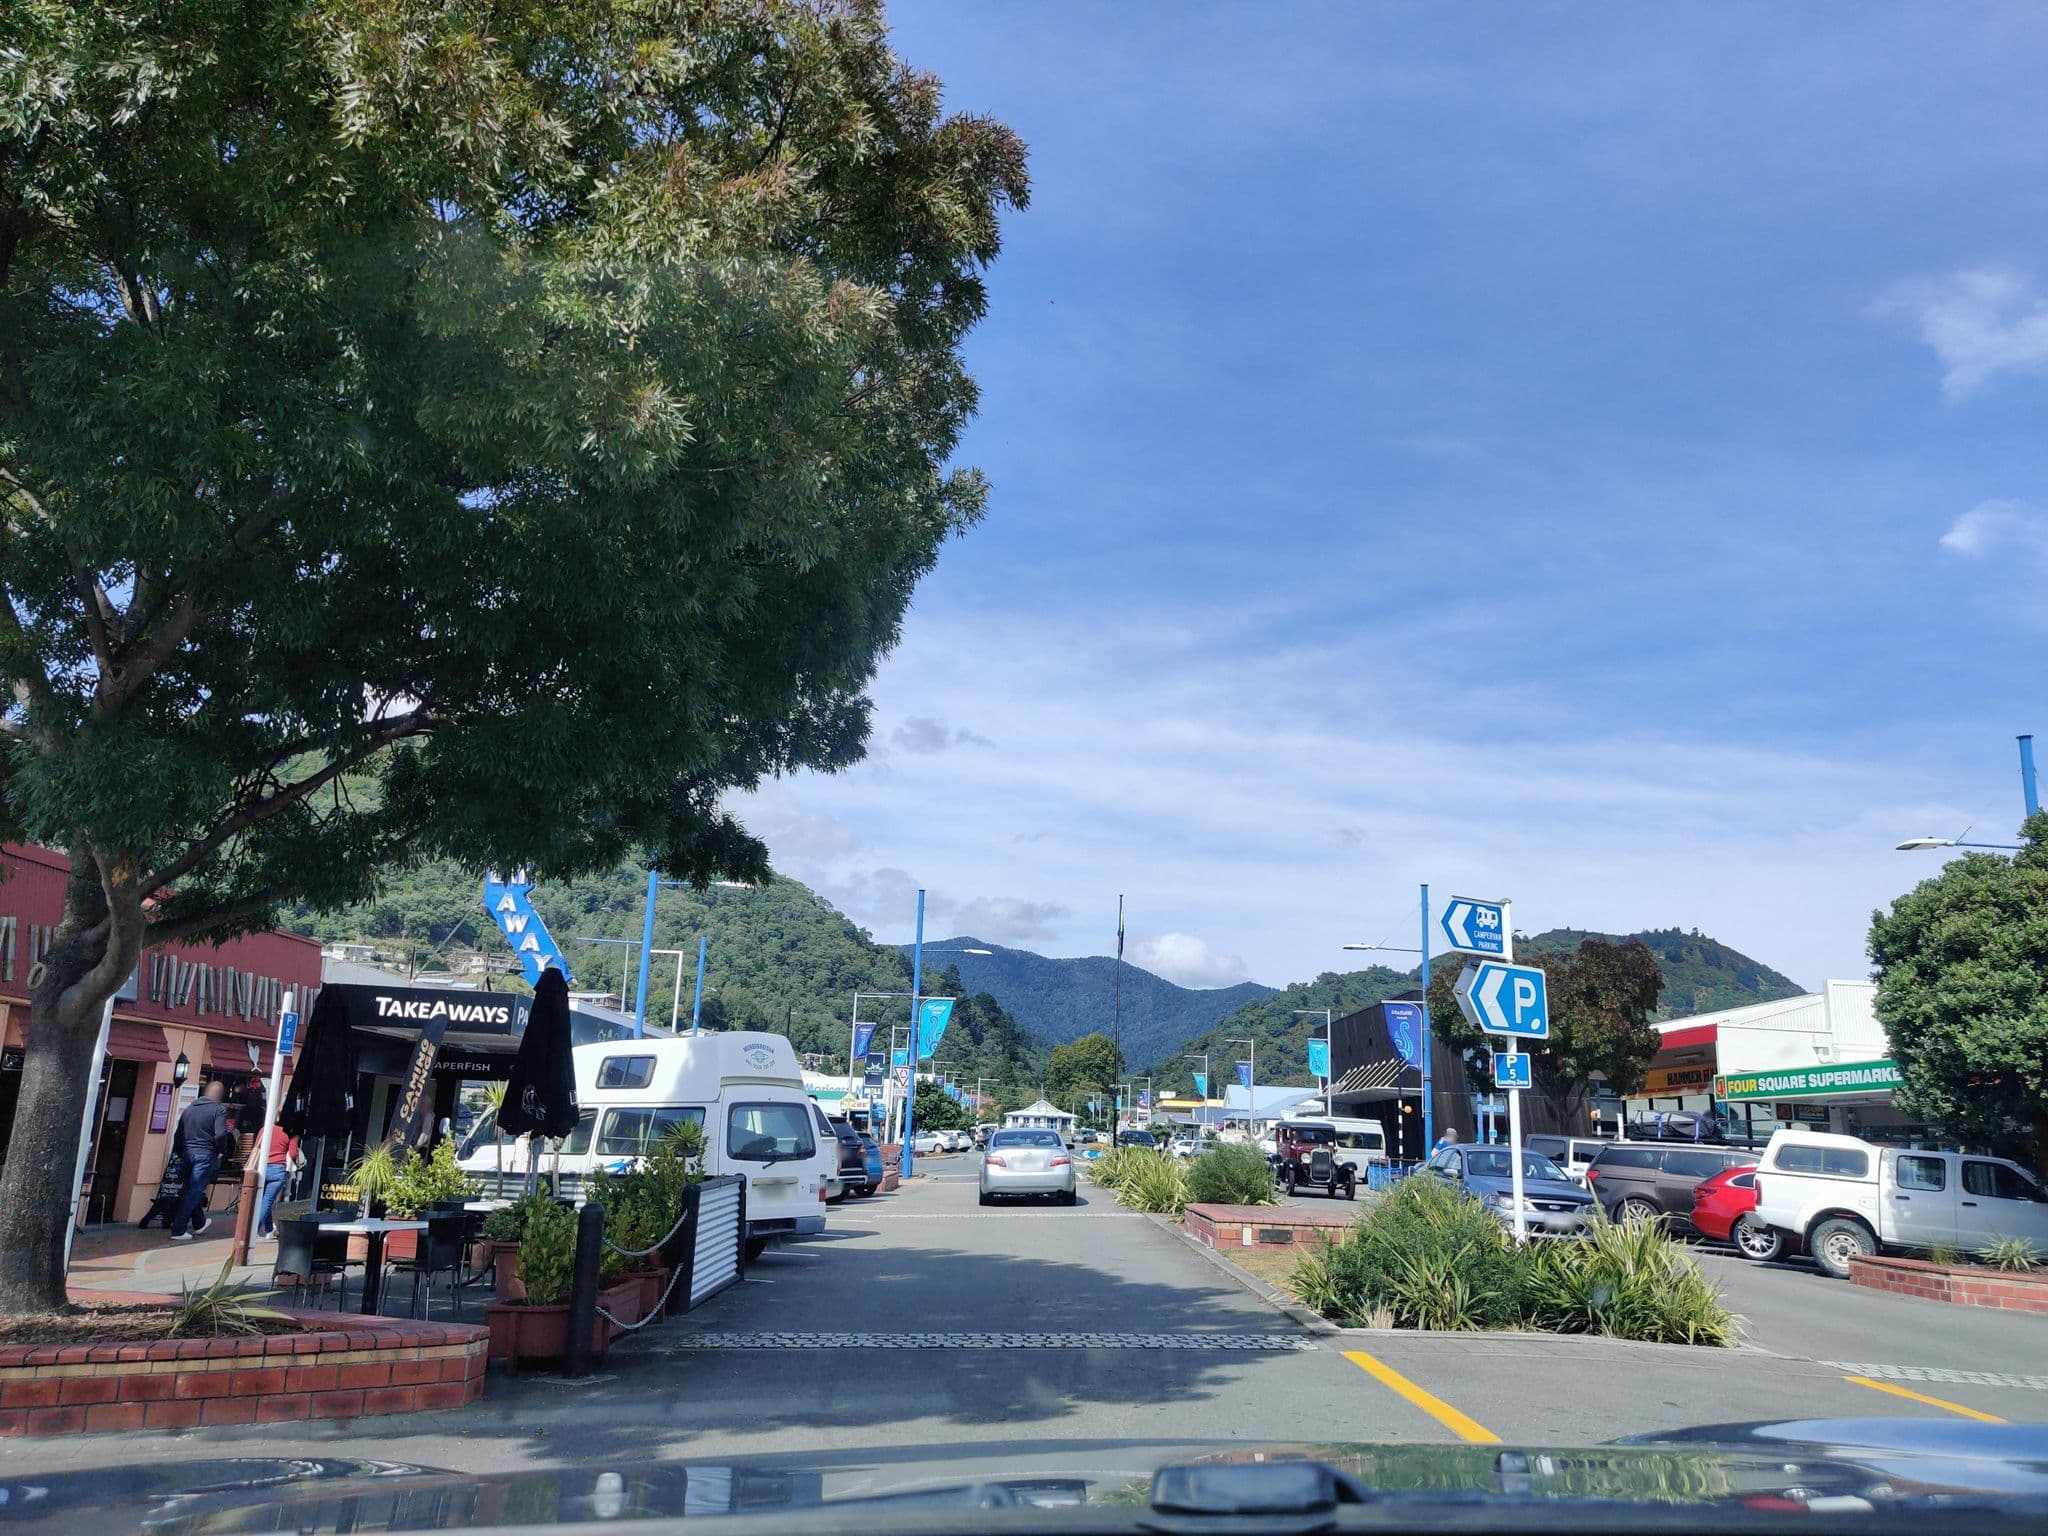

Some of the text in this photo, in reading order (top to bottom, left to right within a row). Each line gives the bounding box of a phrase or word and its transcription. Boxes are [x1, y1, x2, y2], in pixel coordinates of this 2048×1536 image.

[1473, 930, 1502, 940] CAMPERVAN
[1478, 940, 1499, 951] PARKING
[1513, 977, 1537, 1024] P
[375, 996, 509, 1024] TAKEAWAYS
[1506, 1055, 1518, 1068] P
[400, 1039, 430, 1119] GAMING
[1509, 1069, 1517, 1079] 5
[1667, 1070, 1702, 1086] HAMMER
[406, 1042, 436, 1123] LOUNGE
[1728, 1078, 1758, 1093] FOUR
[1758, 1074, 1807, 1092] SQUARE
[321, 1184, 360, 1193] GAMING
[320, 1192, 360, 1202] LOUNGE
